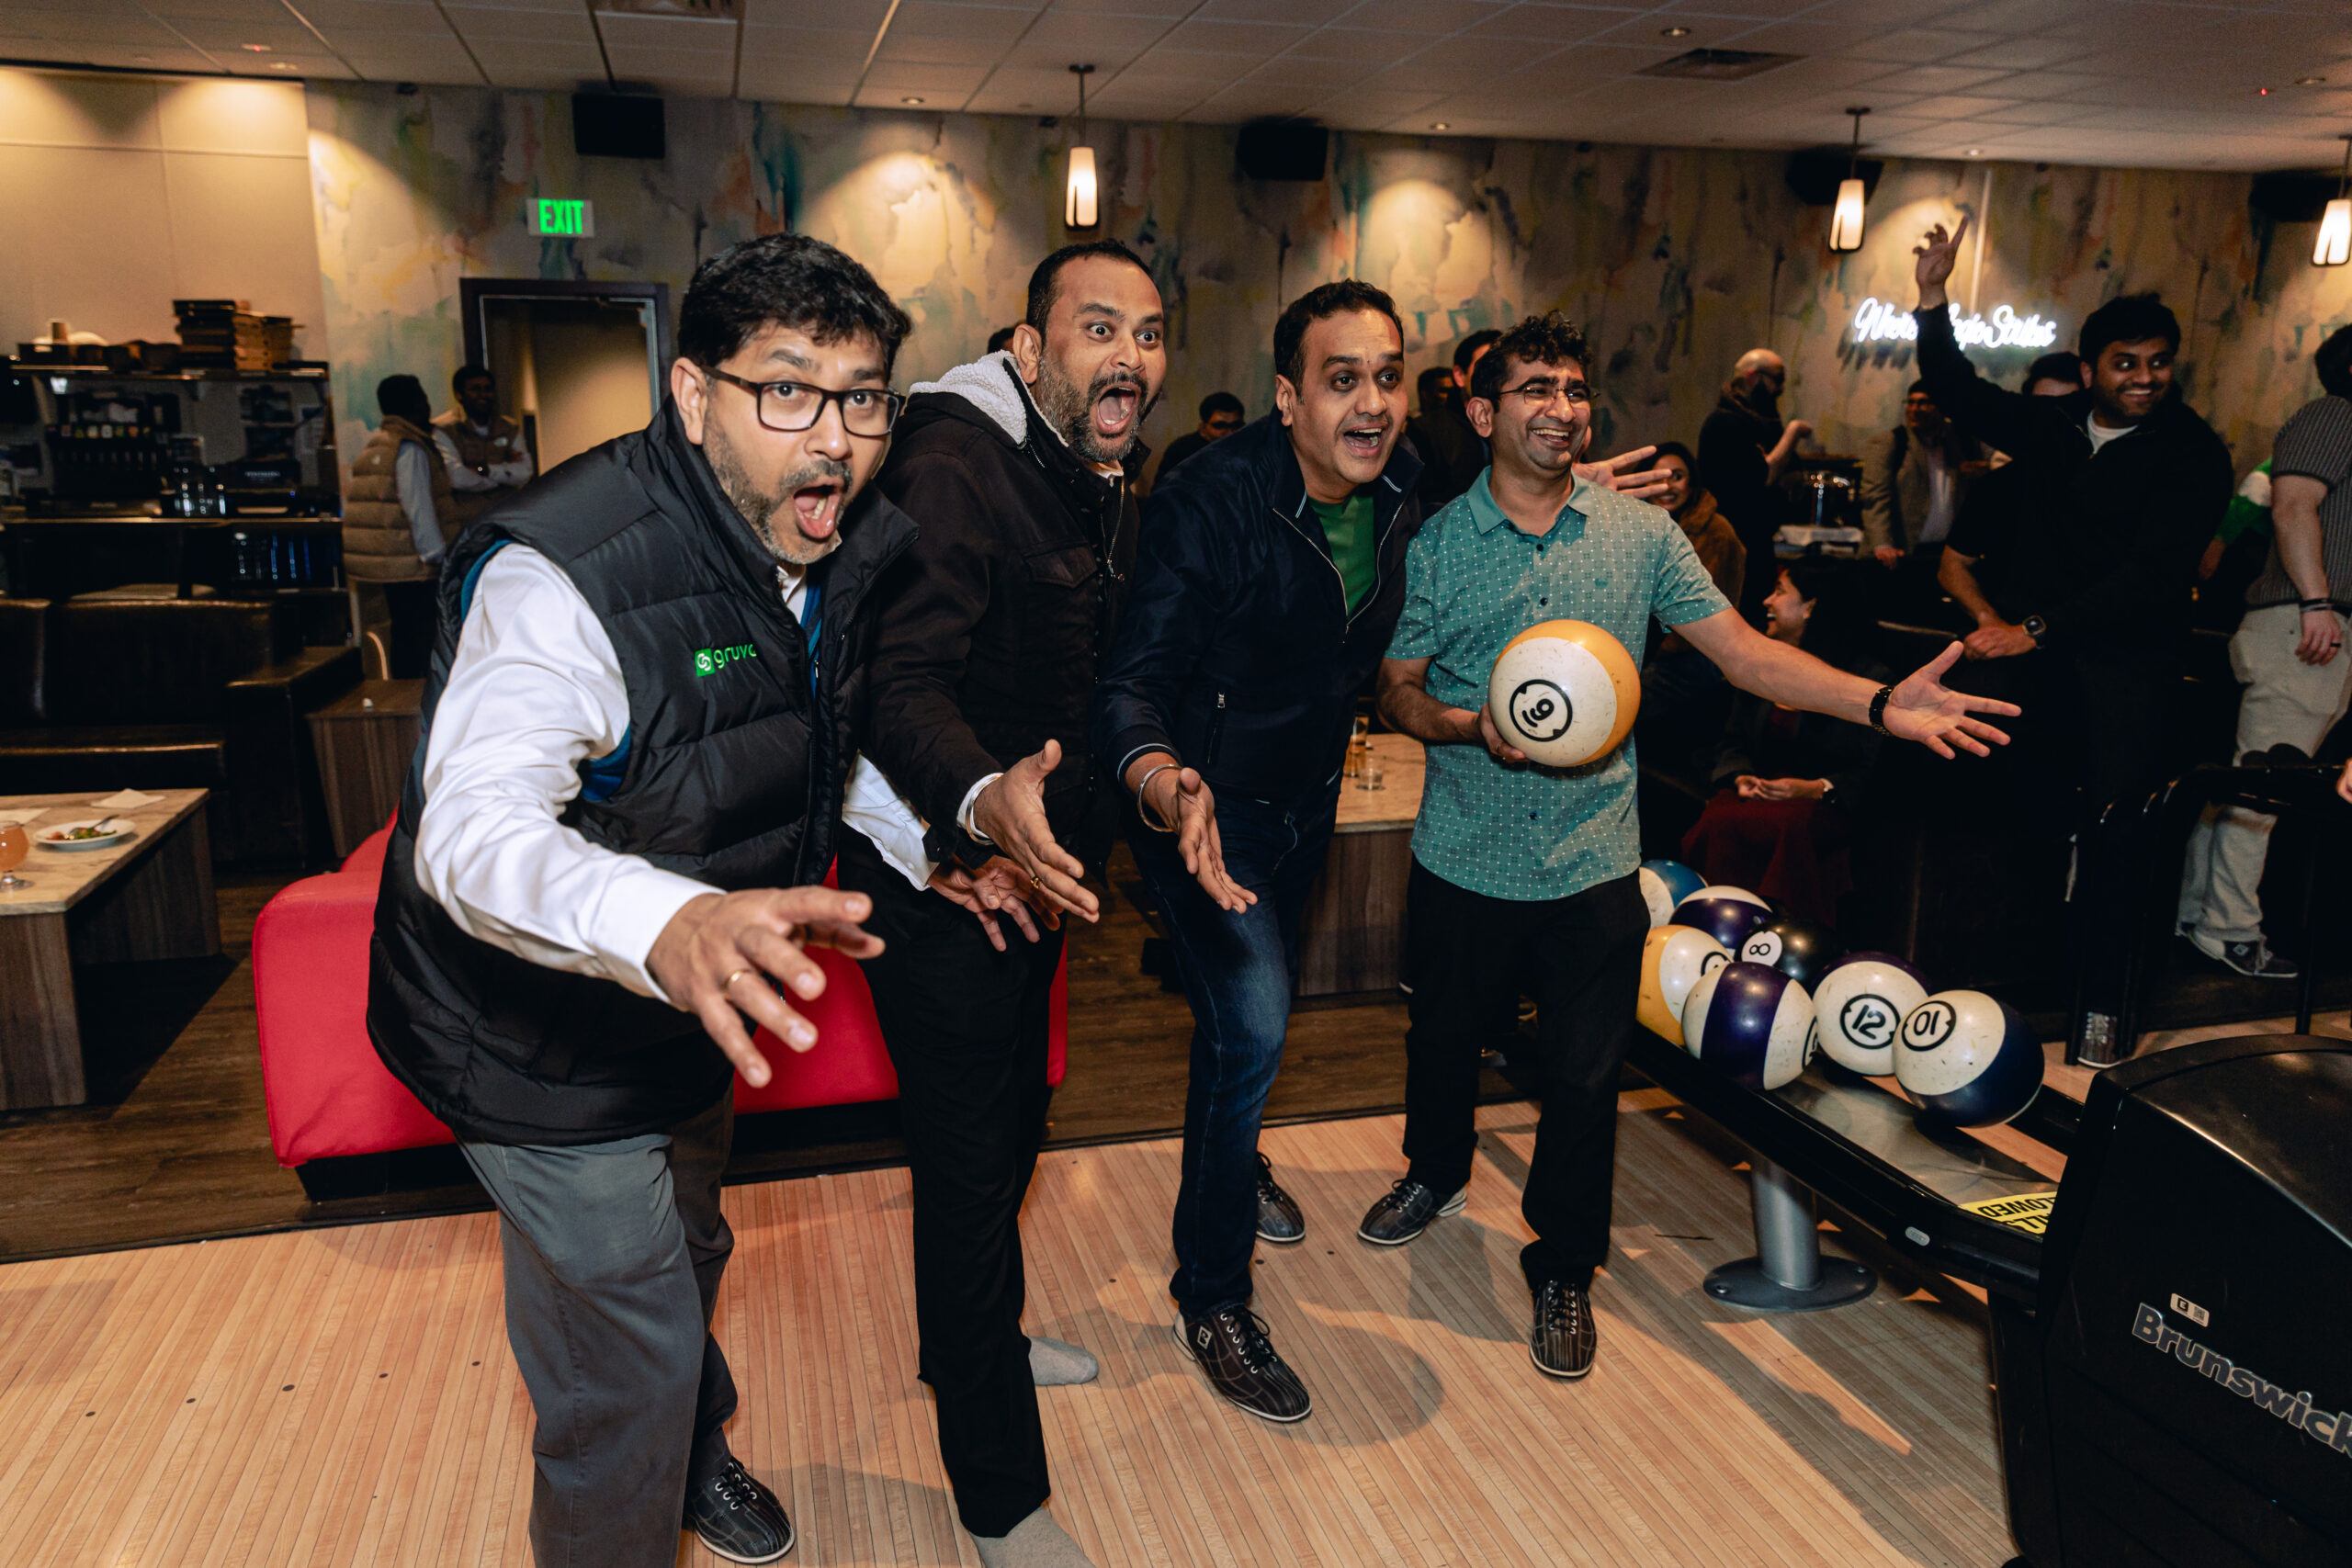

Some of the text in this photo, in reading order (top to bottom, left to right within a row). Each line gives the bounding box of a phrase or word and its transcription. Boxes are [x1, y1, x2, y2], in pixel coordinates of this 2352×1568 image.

[538, 198, 584, 234] EXIT
[1748, 942, 1771, 956] 8
[1851, 1004, 1886, 1040] 12
[1913, 1010, 1941, 1036] 10
[2132, 1302, 2352, 1459] Brunswick
